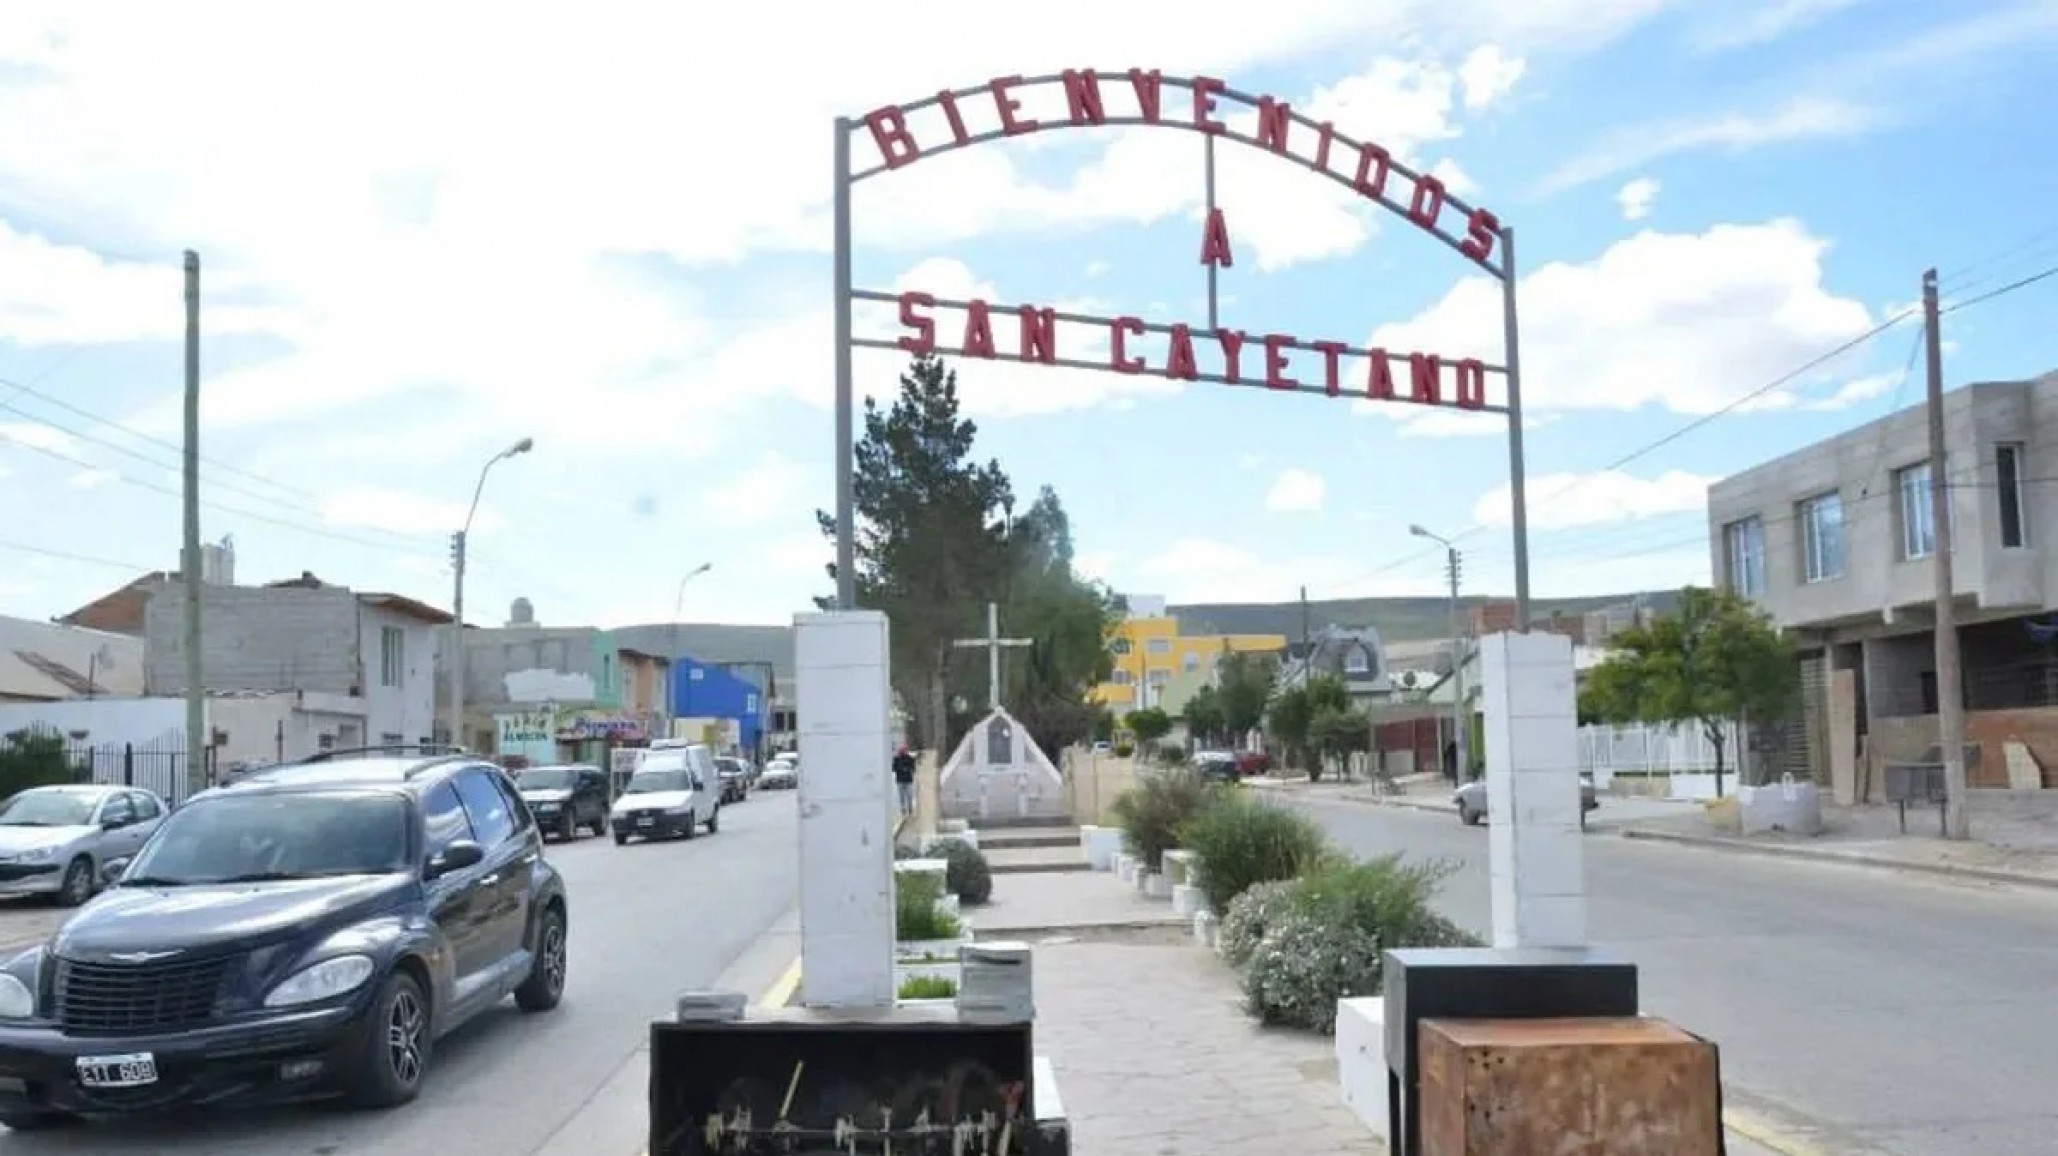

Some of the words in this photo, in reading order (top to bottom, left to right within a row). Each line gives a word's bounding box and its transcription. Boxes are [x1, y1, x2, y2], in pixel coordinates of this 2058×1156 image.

[864, 67, 1500, 263] BIENVENIDOS
[1200, 206, 1233, 267] A
[896, 291, 1056, 365] SAN
[1110, 316, 1486, 411] CAYETANO
